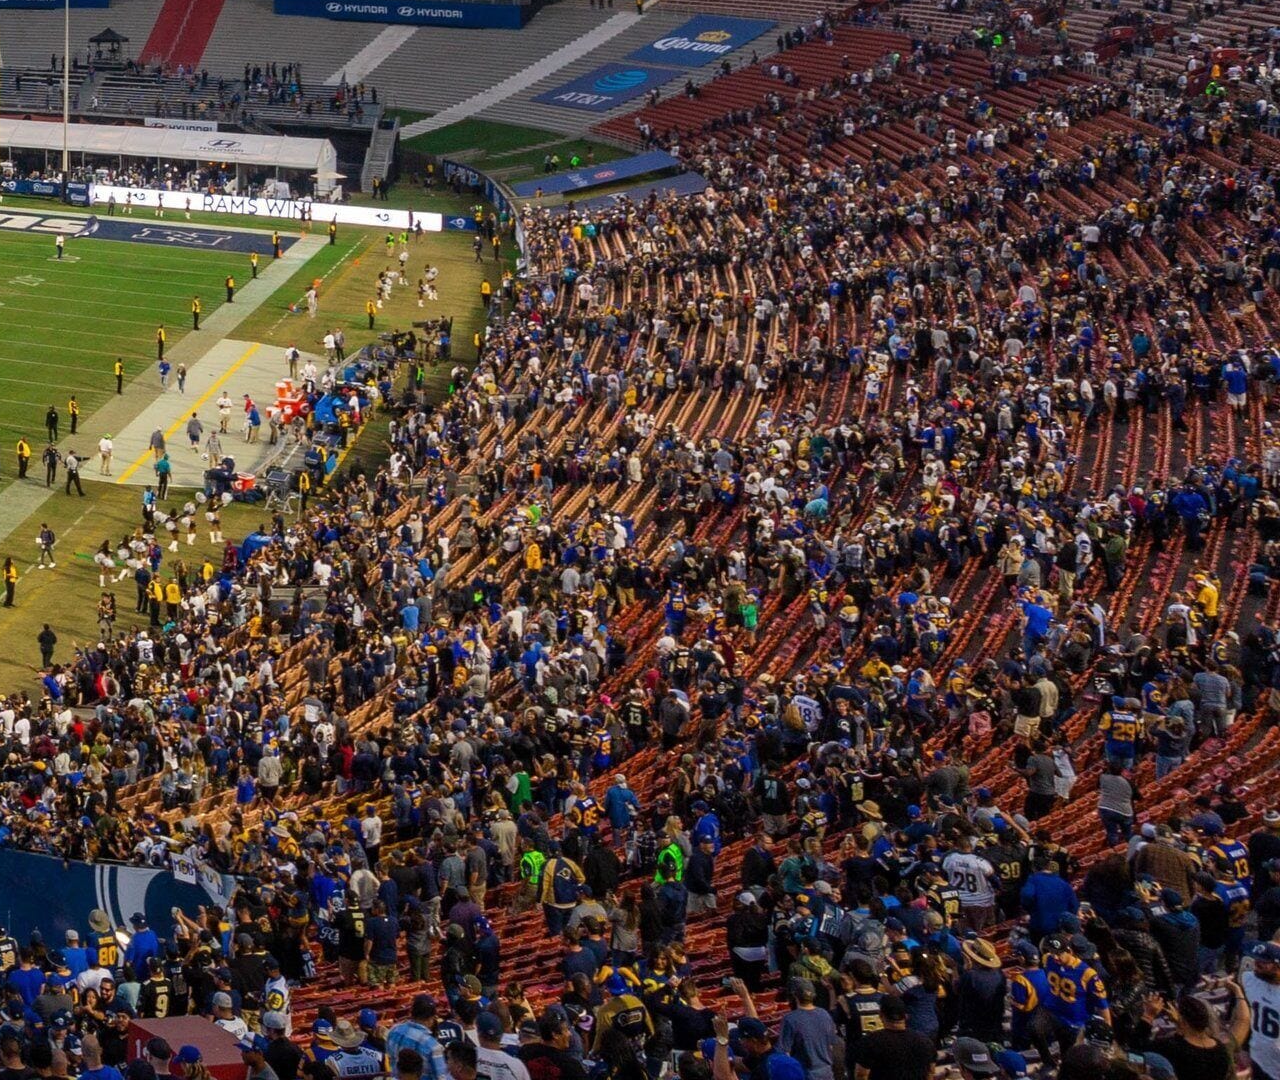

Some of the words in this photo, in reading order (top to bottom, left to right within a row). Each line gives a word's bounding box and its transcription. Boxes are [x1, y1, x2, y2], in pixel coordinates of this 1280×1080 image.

[344, 5, 387, 14] HYUNDAI
[417, 9, 463, 18] HYUNDAI
[653, 37, 732, 53] Corona
[554, 91, 614, 105] AT&T
[203, 193, 258, 214] RAMS
[629, 711, 642, 725] 13
[1112, 722, 1136, 741] 29
[998, 861, 1021, 880] 30
[1234, 857, 1250, 878] 13
[952, 870, 977, 893] 28
[354, 920, 365, 938] 9
[98, 944, 118, 967] 80
[1047, 970, 1077, 1004] 99
[155, 993, 169, 1019] 9
[1251, 1000, 1280, 1040] 16
[347, 1066, 368, 1075] GURLEY
